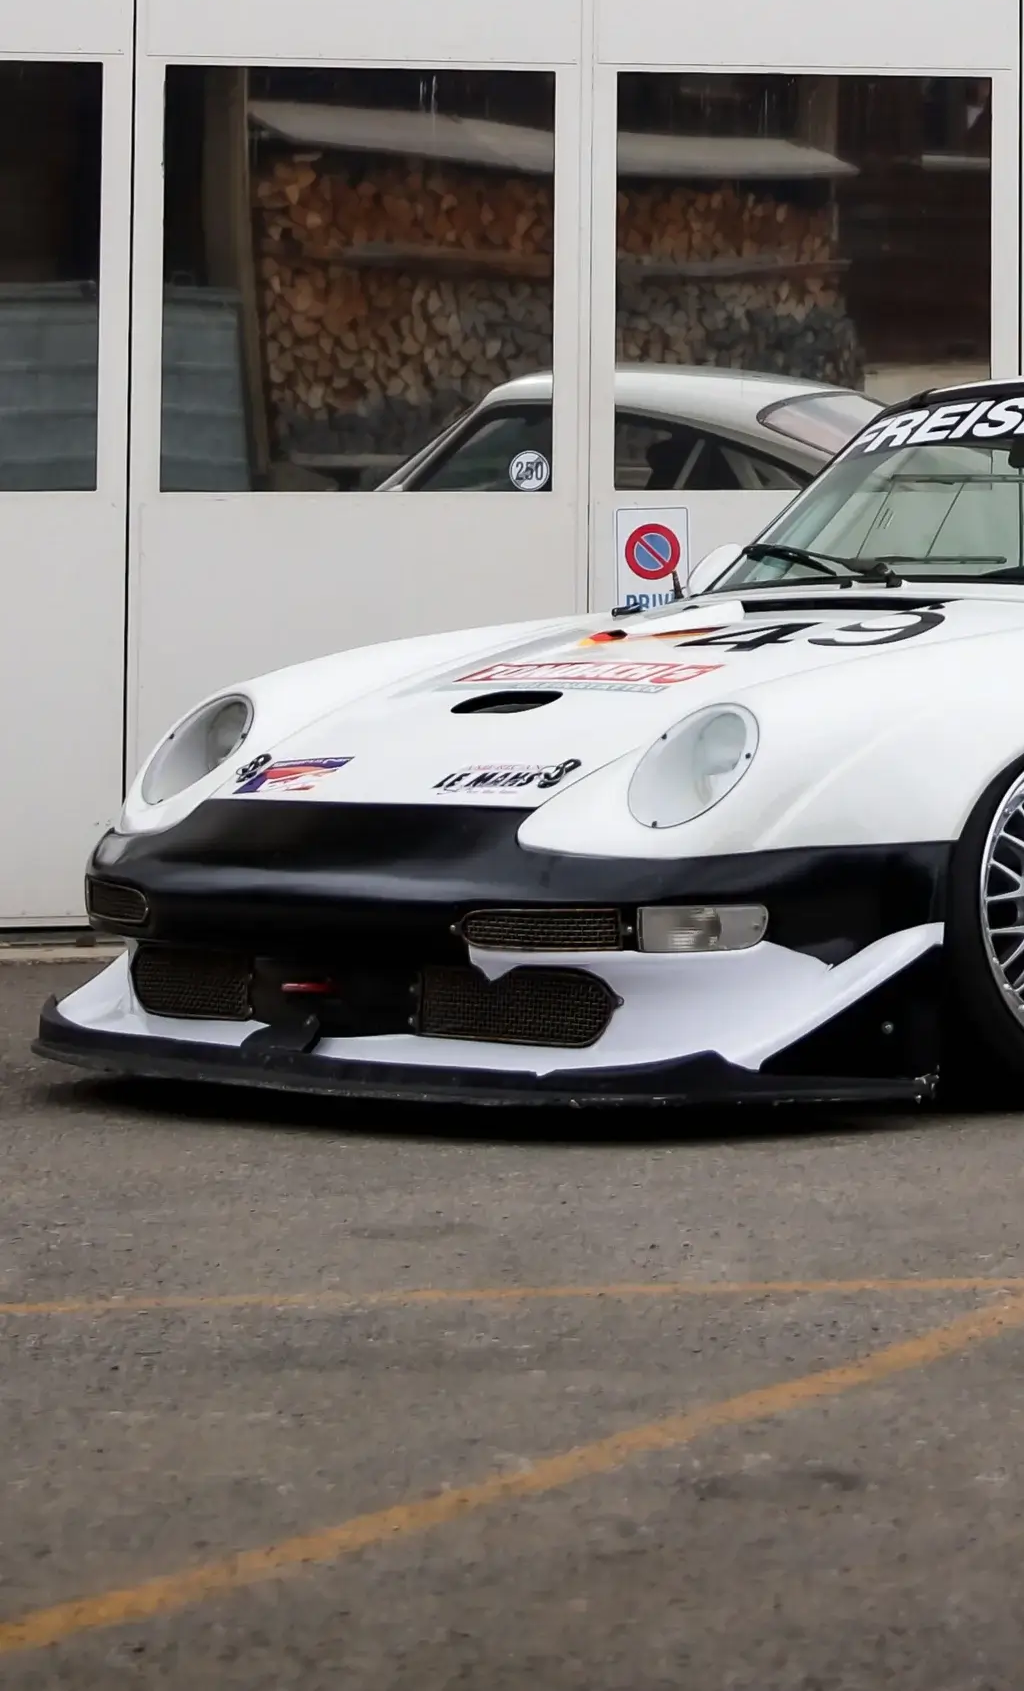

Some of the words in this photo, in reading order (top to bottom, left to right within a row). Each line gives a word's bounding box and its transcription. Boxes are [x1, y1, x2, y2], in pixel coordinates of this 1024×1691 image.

[515, 461, 545, 481] 250
[625, 593, 677, 609] PRIV
[674, 610, 946, 653] 49
